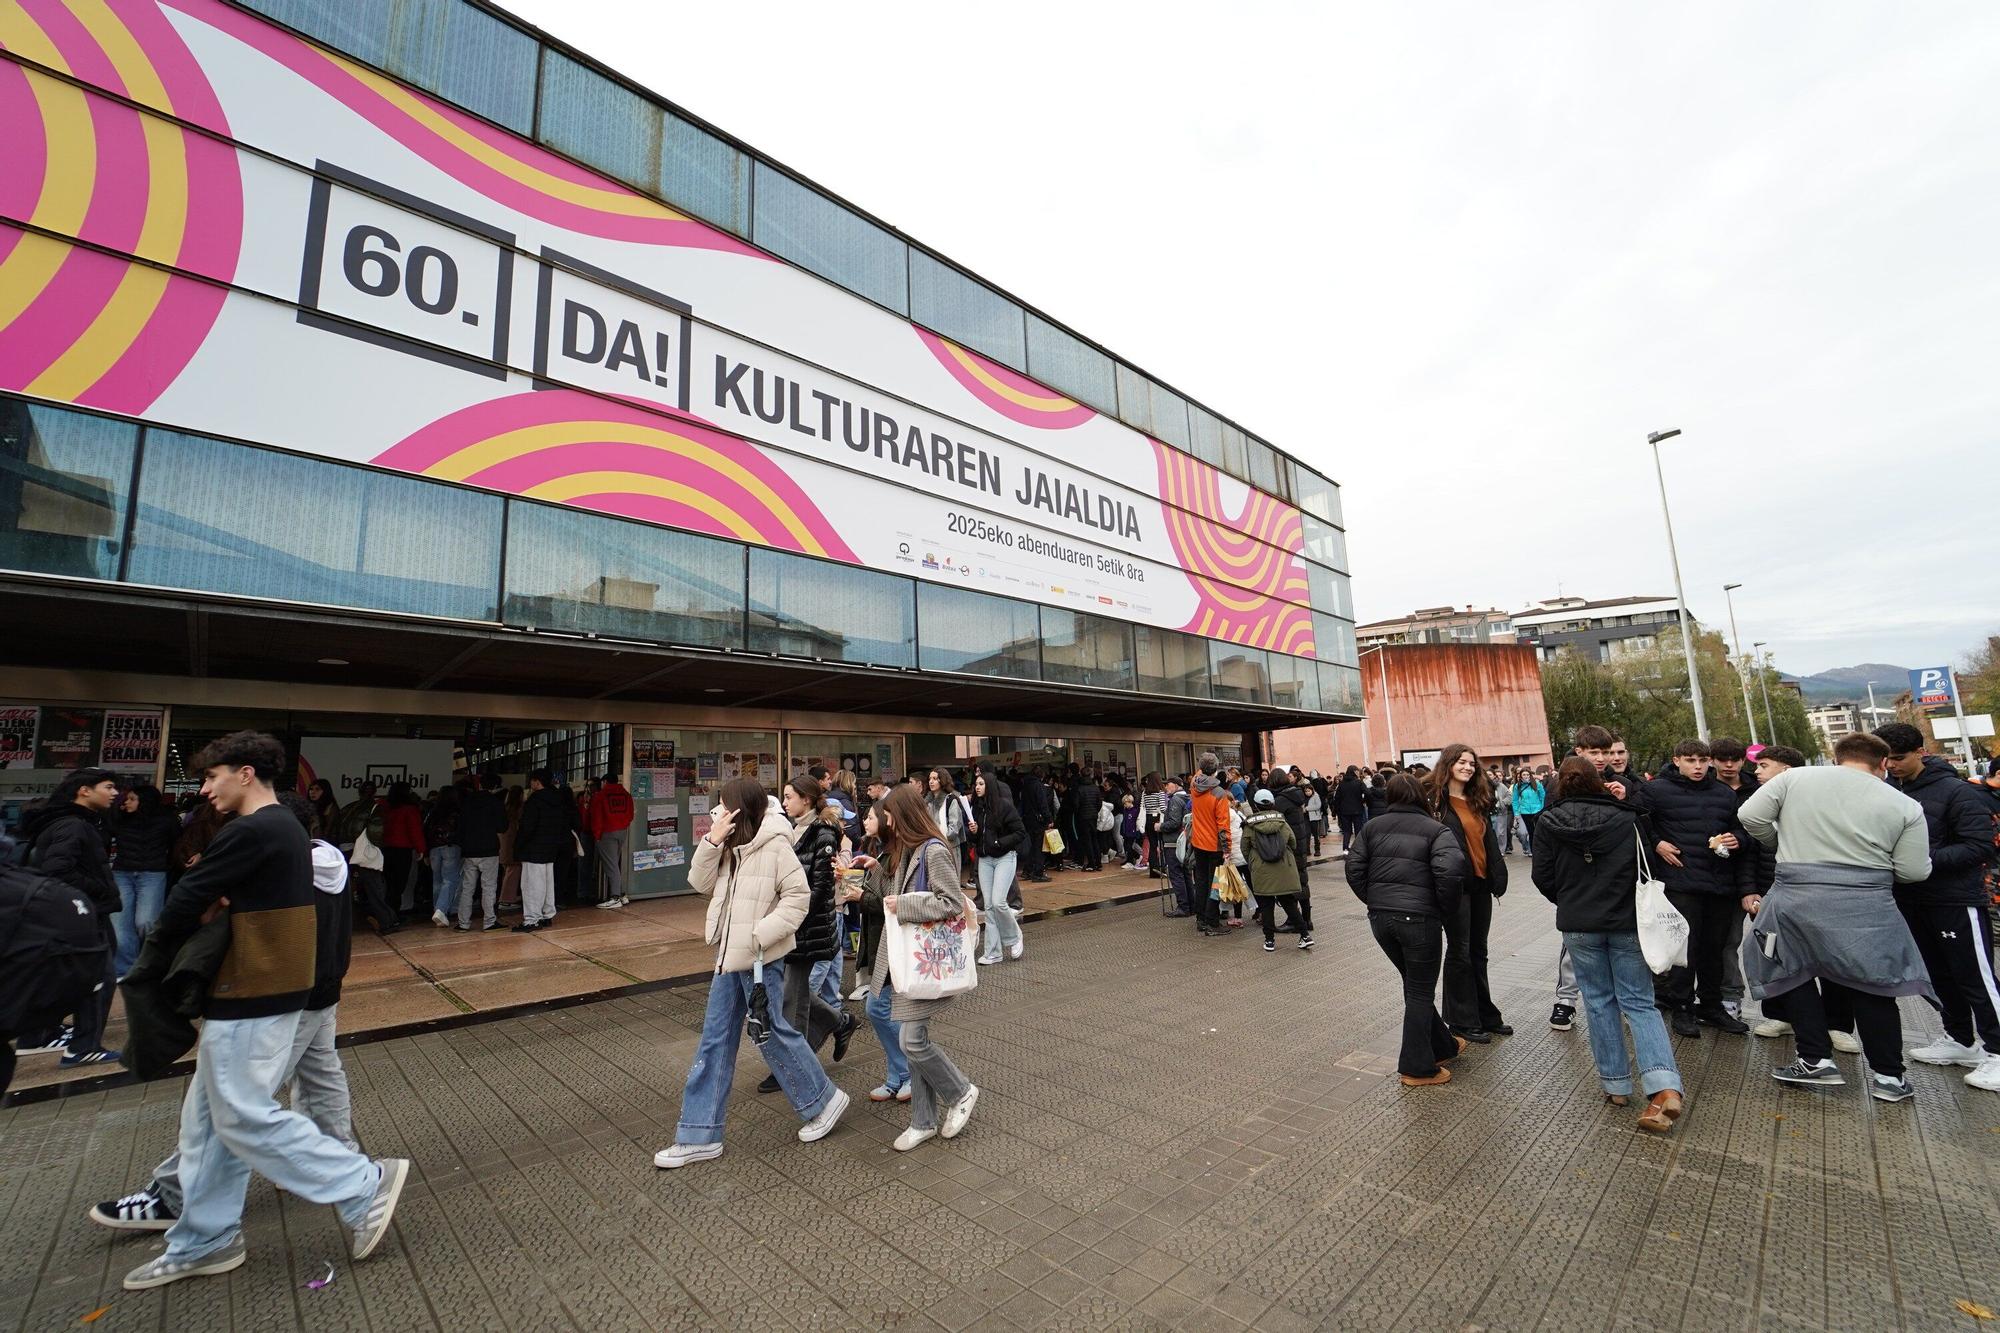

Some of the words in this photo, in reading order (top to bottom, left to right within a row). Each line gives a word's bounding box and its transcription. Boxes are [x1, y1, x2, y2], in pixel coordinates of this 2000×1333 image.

[342, 224, 479, 327] 60.
[562, 298, 668, 387] DA!
[714, 354, 1001, 497] KULTURAREN
[1015, 466, 1141, 542] JAIALDIA
[947, 512, 1014, 548] 2025eko
[1018, 534, 1093, 571] abenduaren
[1097, 554, 1126, 579] 5etik
[1127, 563, 1145, 582] 8ra
[1920, 670, 1942, 688] P
[107, 718, 160, 729] EUSKAL
[105, 729, 160, 740] ESTATU
[341, 774, 362, 789] ba
[409, 773, 429, 788] bil
